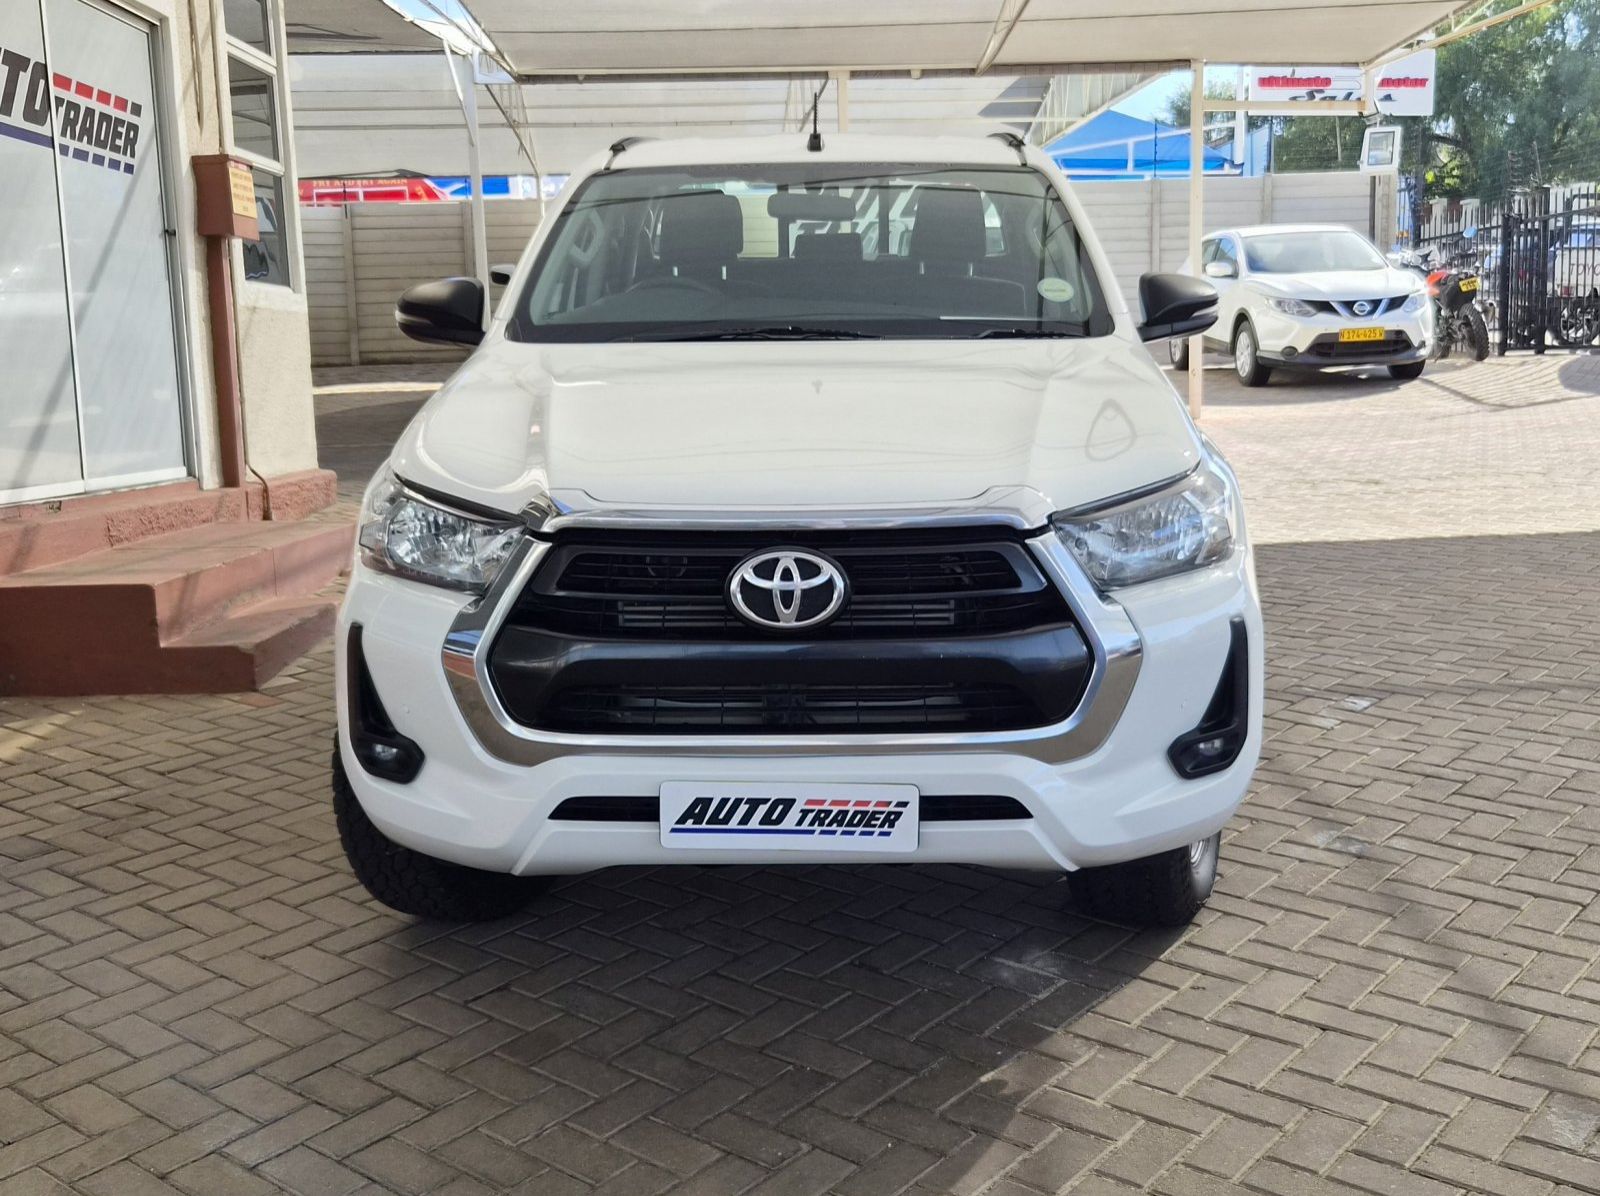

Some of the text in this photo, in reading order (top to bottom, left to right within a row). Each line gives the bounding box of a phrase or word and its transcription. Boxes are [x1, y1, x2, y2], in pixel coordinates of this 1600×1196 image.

[0, 47, 50, 127] TO
[674, 797, 904, 829] AUTO TRADER
